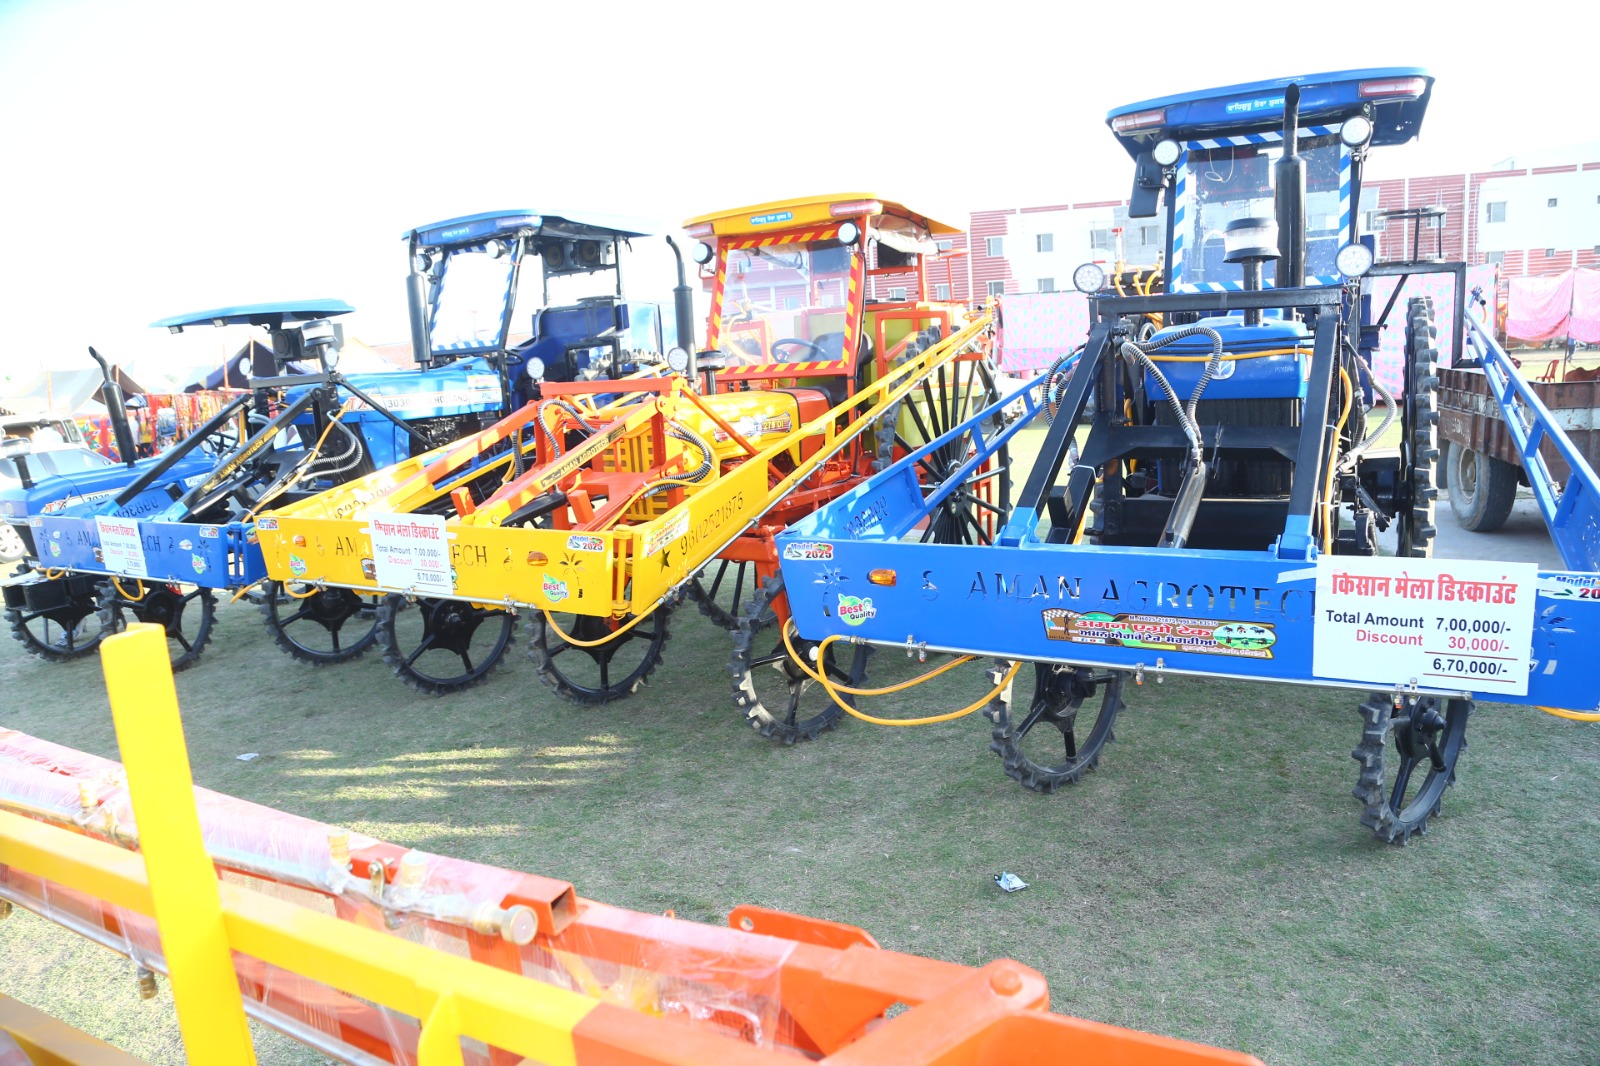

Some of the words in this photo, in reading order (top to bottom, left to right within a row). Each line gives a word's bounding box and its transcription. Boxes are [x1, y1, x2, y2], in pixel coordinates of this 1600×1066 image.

[561, 458, 580, 476] AMAN
[374, 519, 396, 537] किसान
[680, 491, 744, 555] 9602521875
[389, 545, 412, 555] Amount
[582, 542, 603, 550] 2025
[791, 543, 813, 551] Model
[804, 550, 832, 559] 2025
[967, 571, 1083, 607] AMAN
[1332, 571, 1391, 597] किसान
[1395, 571, 1435, 601] मेला
[1437, 573, 1518, 604] डिस्काउंट
[1556, 576, 1596, 587] Model
[1579, 587, 1600, 599] 20
[840, 603, 863, 615] Best
[849, 610, 875, 620] Quality
[1075, 620, 1128, 631] अमन
[1132, 622, 1172, 634] एग्रो
[1176, 625, 1213, 637] टेक
[1326, 609, 1360, 624] Total
[1364, 612, 1424, 629] Amount
[1436, 617, 1511, 635] 7,00,000/-
[1356, 629, 1423, 646] Discount
[1448, 636, 1510, 653] 30,000/-
[1433, 658, 1508, 675] 6,70,000/-
